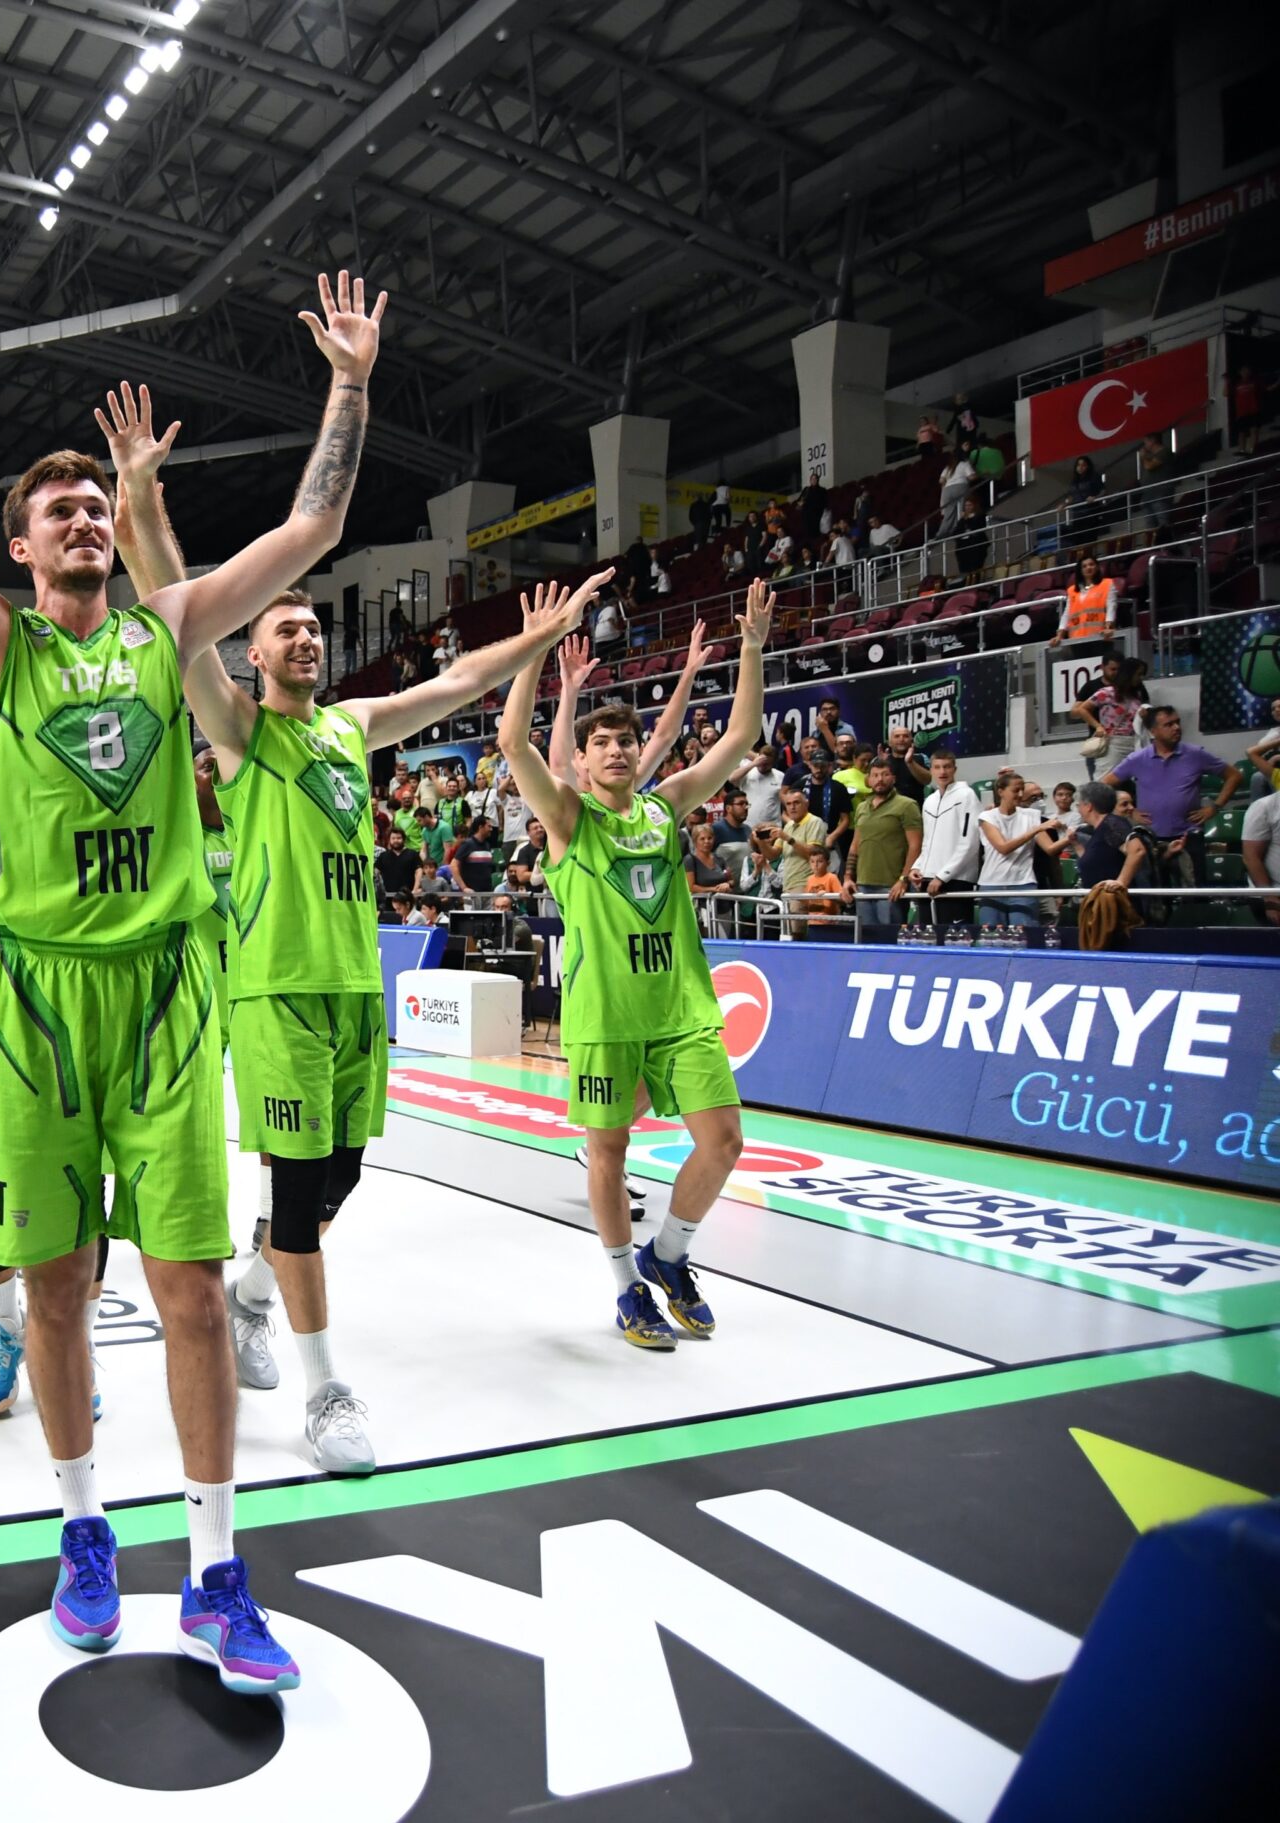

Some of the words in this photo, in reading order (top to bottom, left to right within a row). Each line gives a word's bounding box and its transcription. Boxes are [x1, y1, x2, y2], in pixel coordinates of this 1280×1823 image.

[807, 443, 826, 462] 302
[601, 517, 614, 533] 301
[888, 690, 929, 710] BASKETBOL
[930, 681, 956, 701] KENTİ
[1060, 664, 1103, 704] 10
[88, 711, 127, 771] 8
[74, 826, 155, 897] FIAT
[322, 851, 369, 902] FIAT
[627, 932, 673, 975] FIAT
[421, 997, 459, 1012] TÜRKİYE
[422, 1010, 460, 1026] SİGORTA
[847, 971, 1241, 1078] TÜRKİYE
[578, 1075, 614, 1105] FIAT
[264, 1095, 303, 1133] FIAT
[1012, 1071, 1189, 1164] Gücü,
[764, 1177, 1208, 1287] SİGORTA
[845, 1169, 1280, 1273] TÜRKİYE
